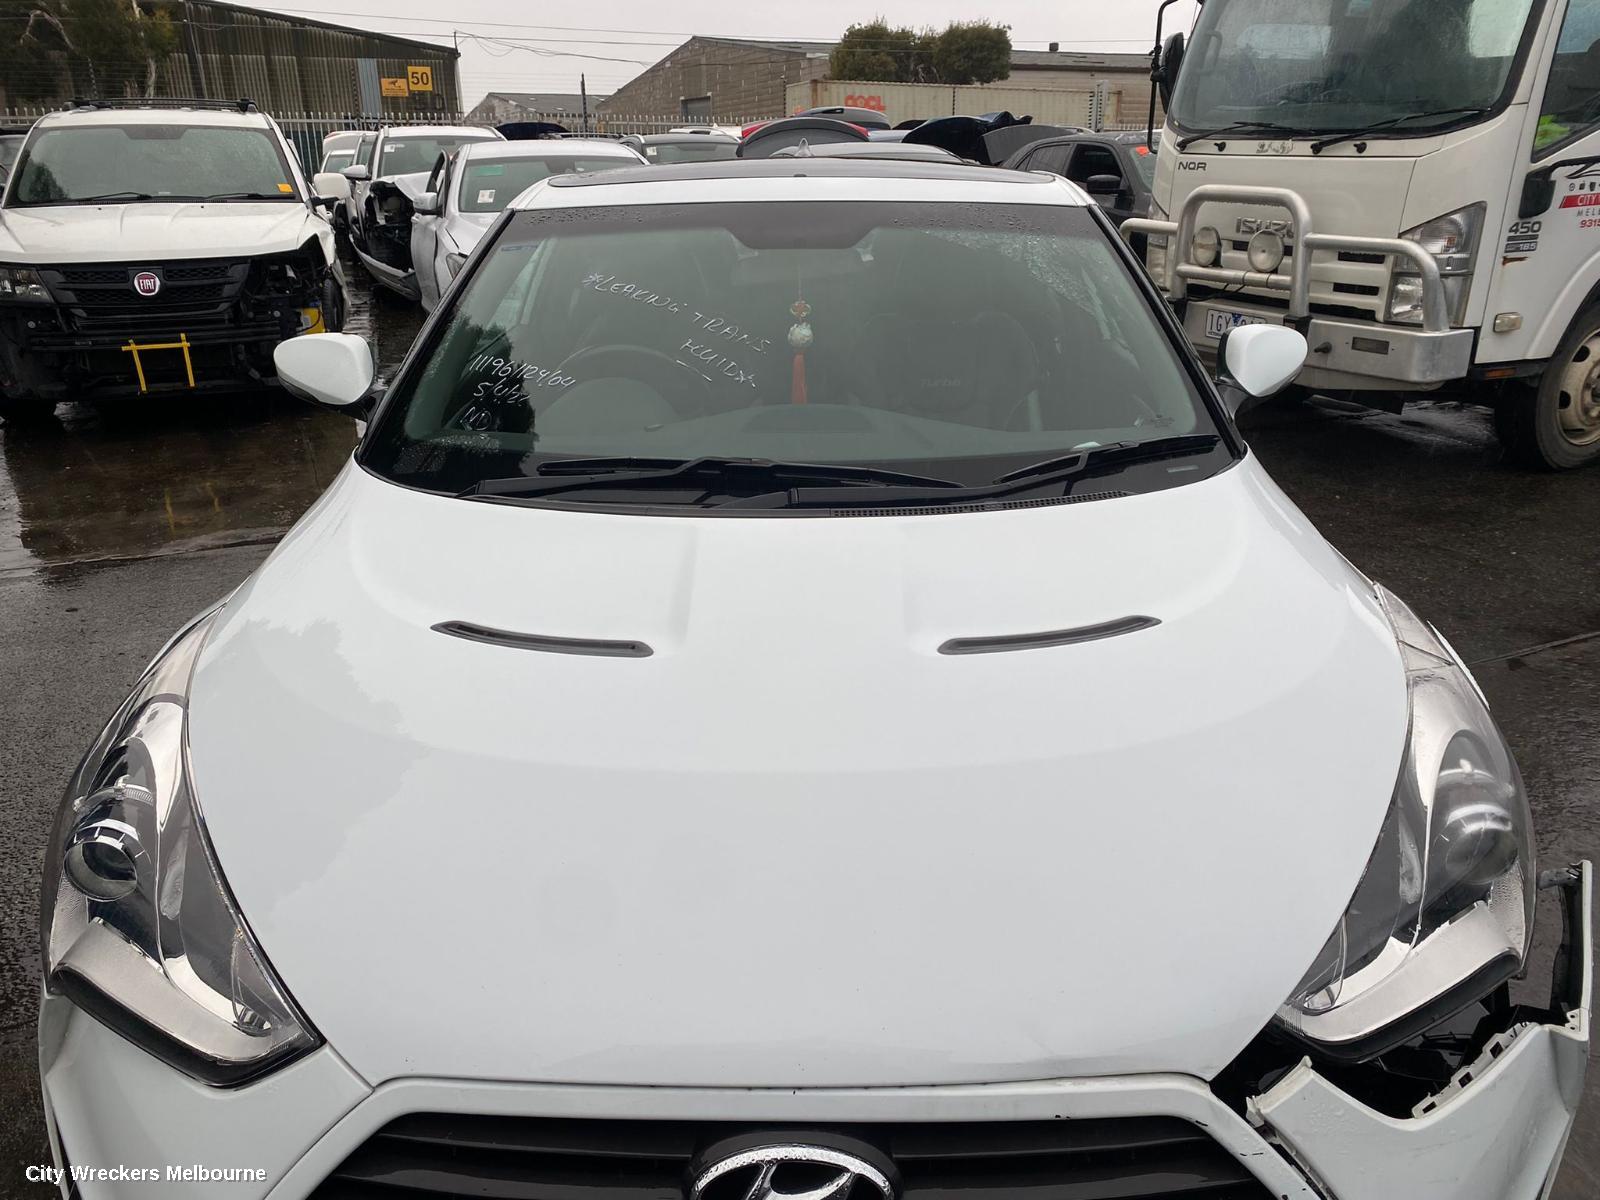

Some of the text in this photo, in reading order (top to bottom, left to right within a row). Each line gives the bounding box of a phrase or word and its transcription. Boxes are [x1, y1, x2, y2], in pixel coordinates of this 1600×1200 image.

[411, 72, 429, 85] 50
[1178, 161, 1208, 171] NQR
[1578, 194, 1597, 206] CITY
[1508, 221, 1542, 234] 450
[139, 279, 155, 290] FIAT
